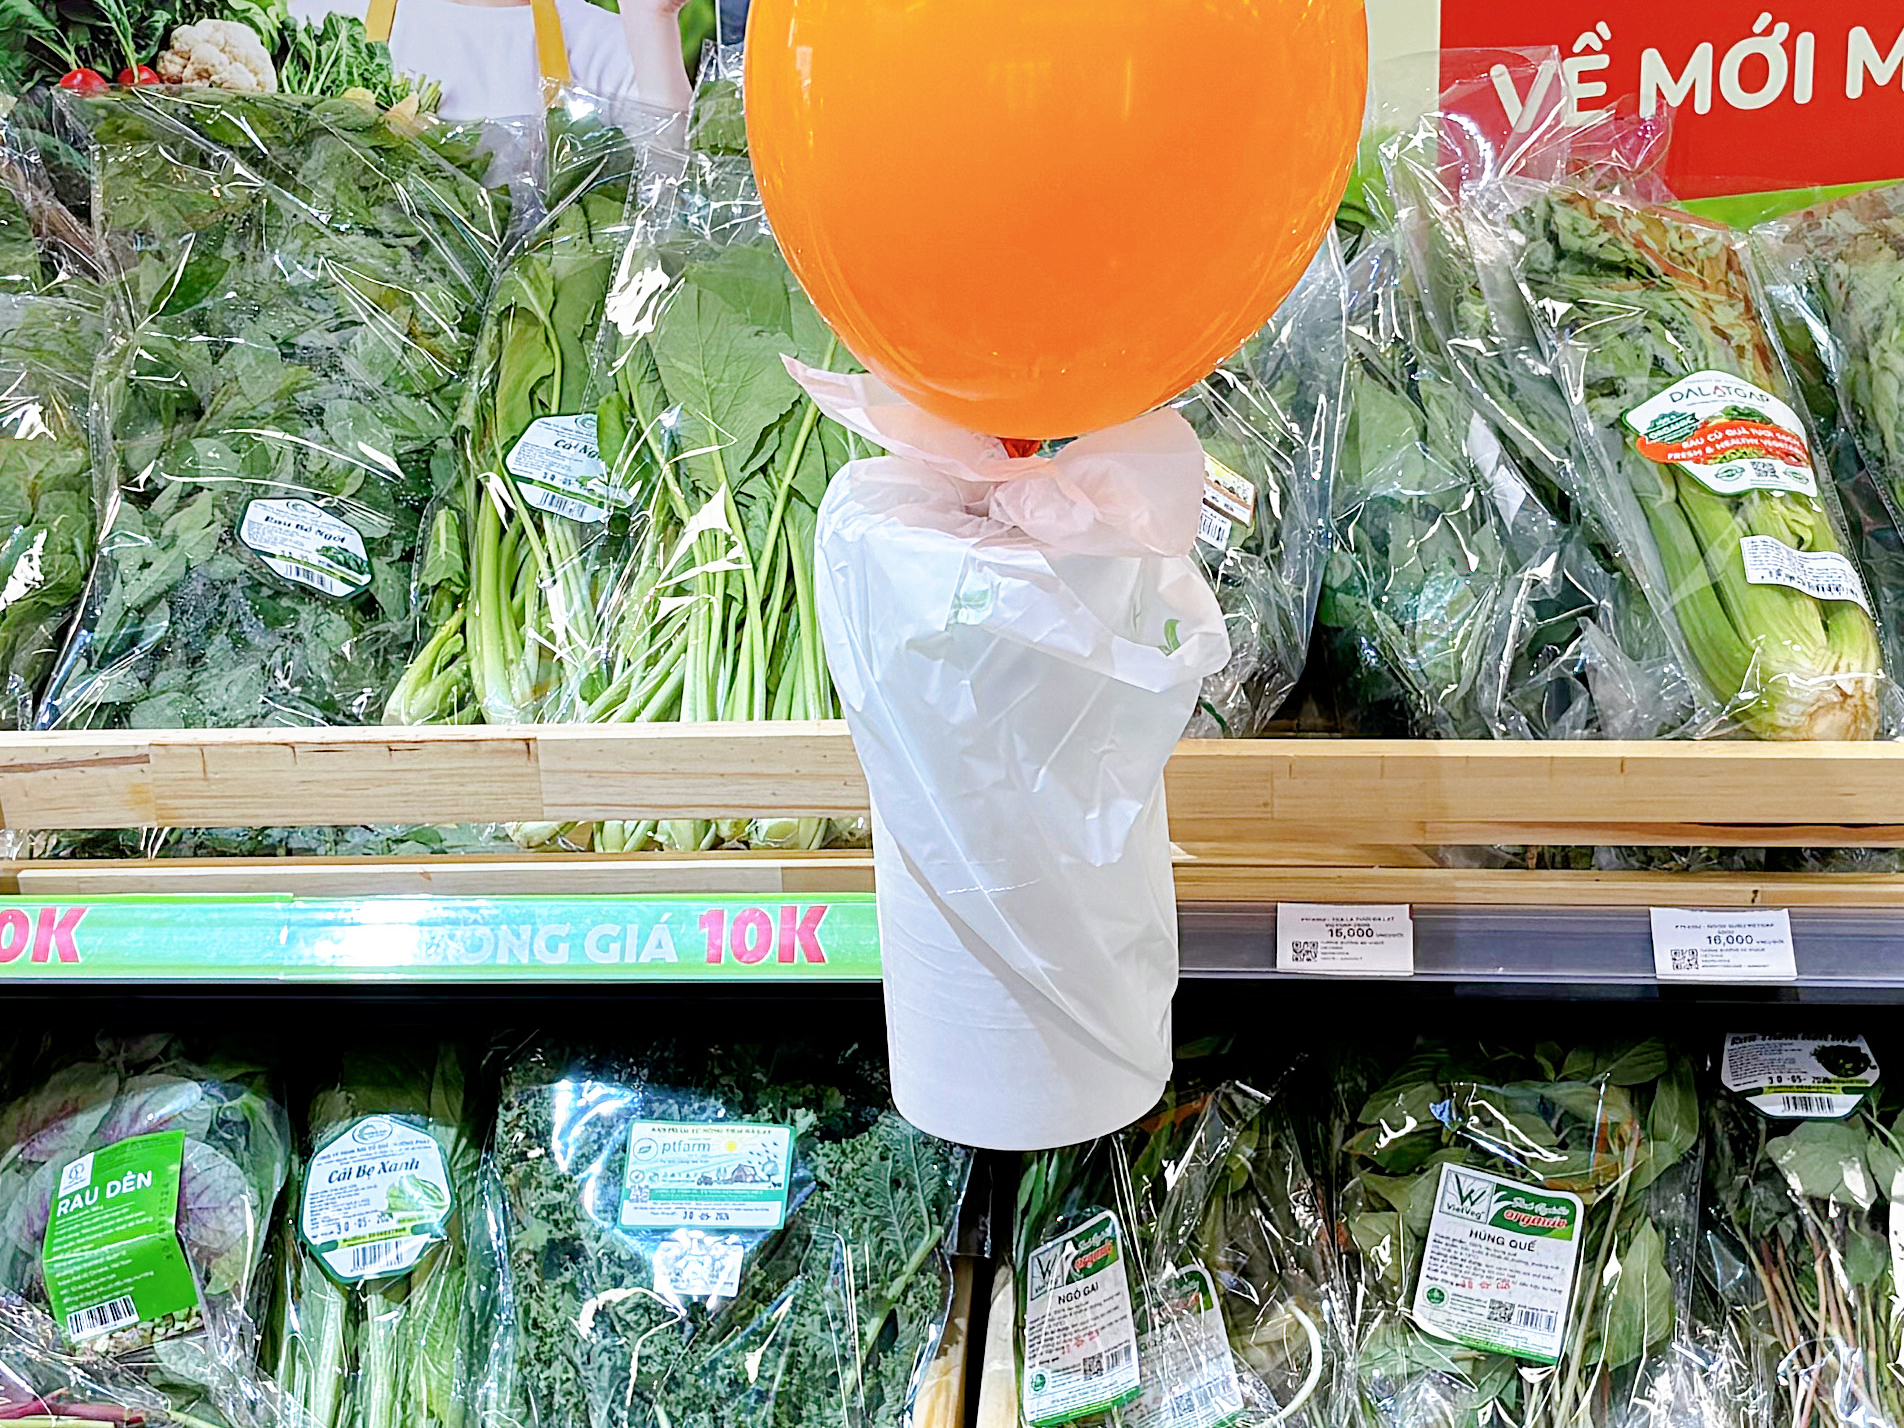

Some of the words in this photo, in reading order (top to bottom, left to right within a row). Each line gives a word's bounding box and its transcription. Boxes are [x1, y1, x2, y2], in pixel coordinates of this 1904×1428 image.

[1489, 18, 1610, 134] VỀ
[1639, 11, 1814, 115] MỚI
[695, 904, 831, 966] 10K
[661, 1139, 711, 1155] ptfarm
[377, 1158, 420, 1176] Xanh
[56, 1185, 99, 1217] RAU
